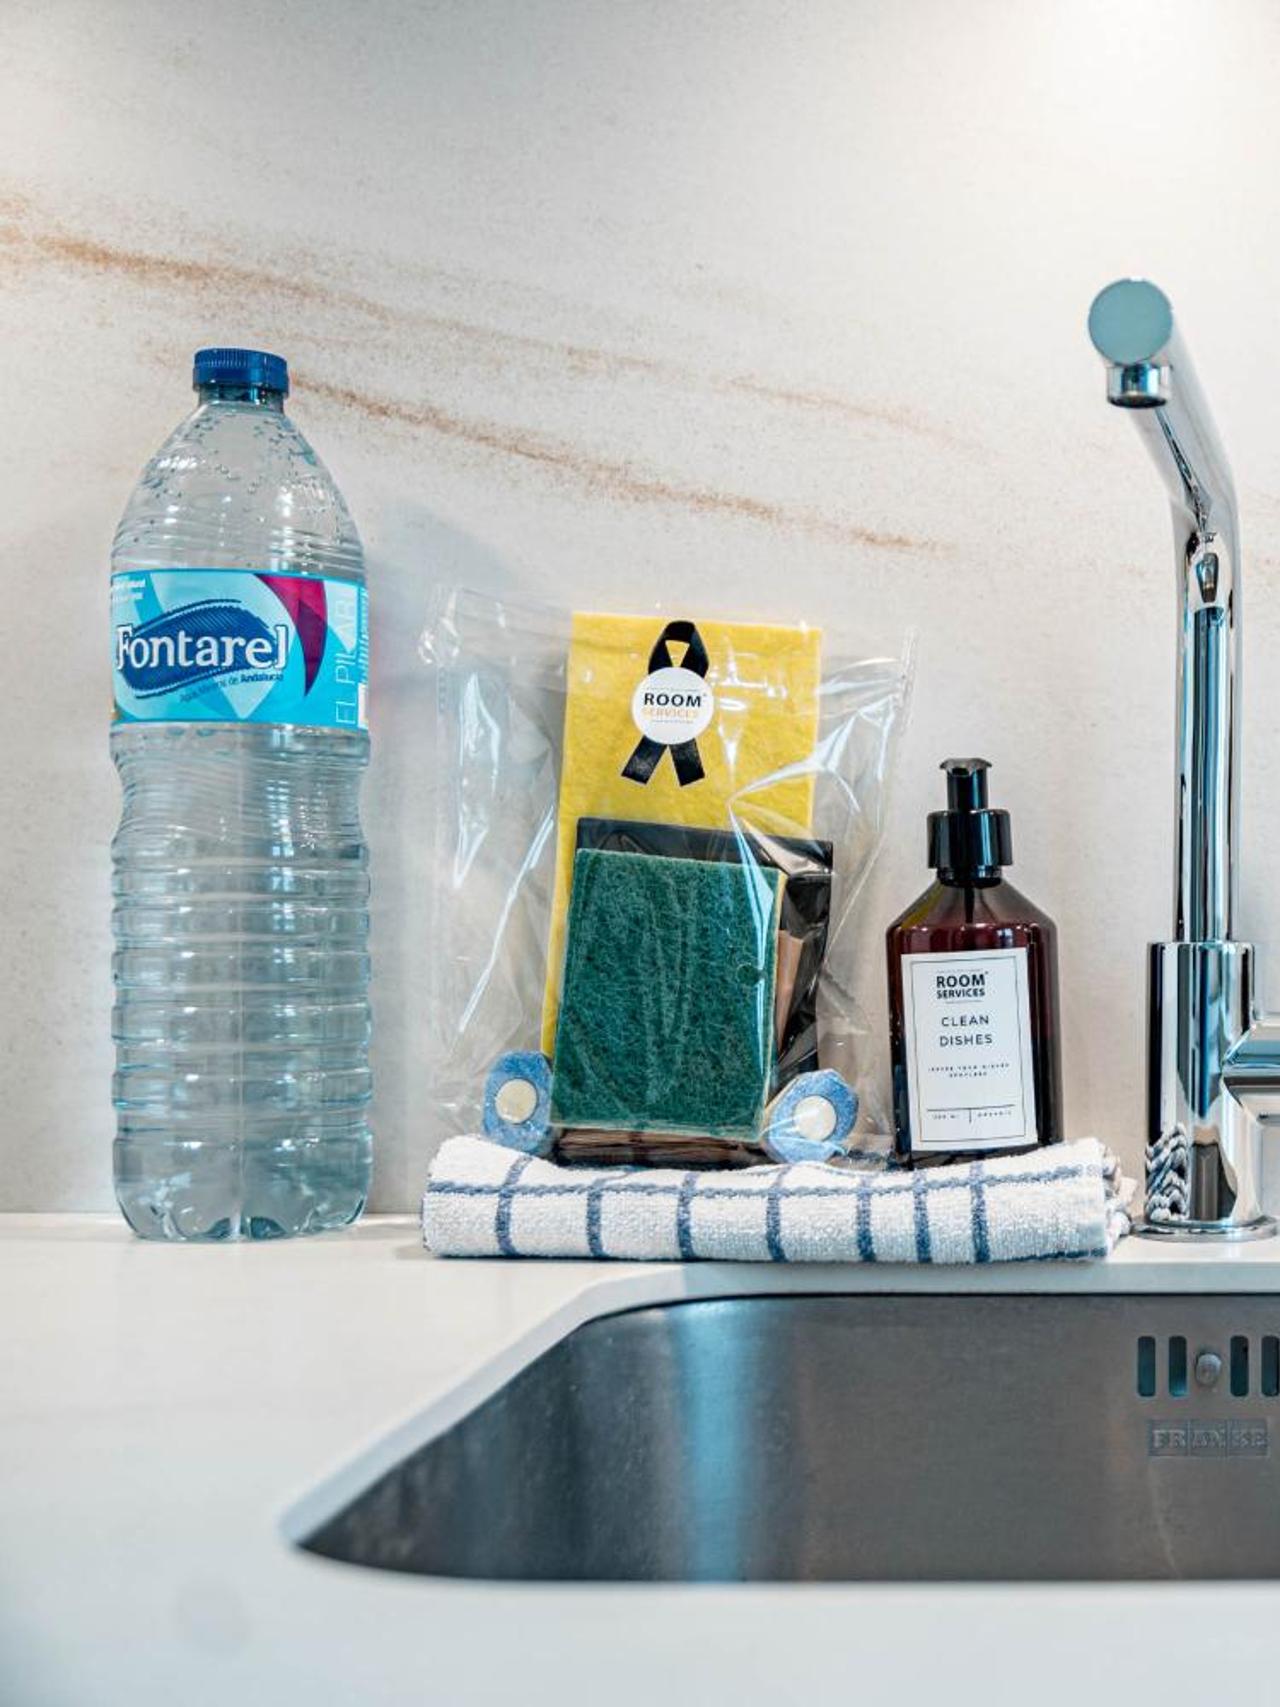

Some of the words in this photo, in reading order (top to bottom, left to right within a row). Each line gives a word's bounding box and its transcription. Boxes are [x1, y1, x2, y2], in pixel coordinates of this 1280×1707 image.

[116, 624, 288, 671] Fontarel
[643, 692, 702, 708] ROOM
[936, 974, 986, 988] ROOM
[936, 988, 986, 1000] SERVICES
[941, 1015, 990, 1027] CLEAN
[939, 1034, 993, 1047] DISHES
